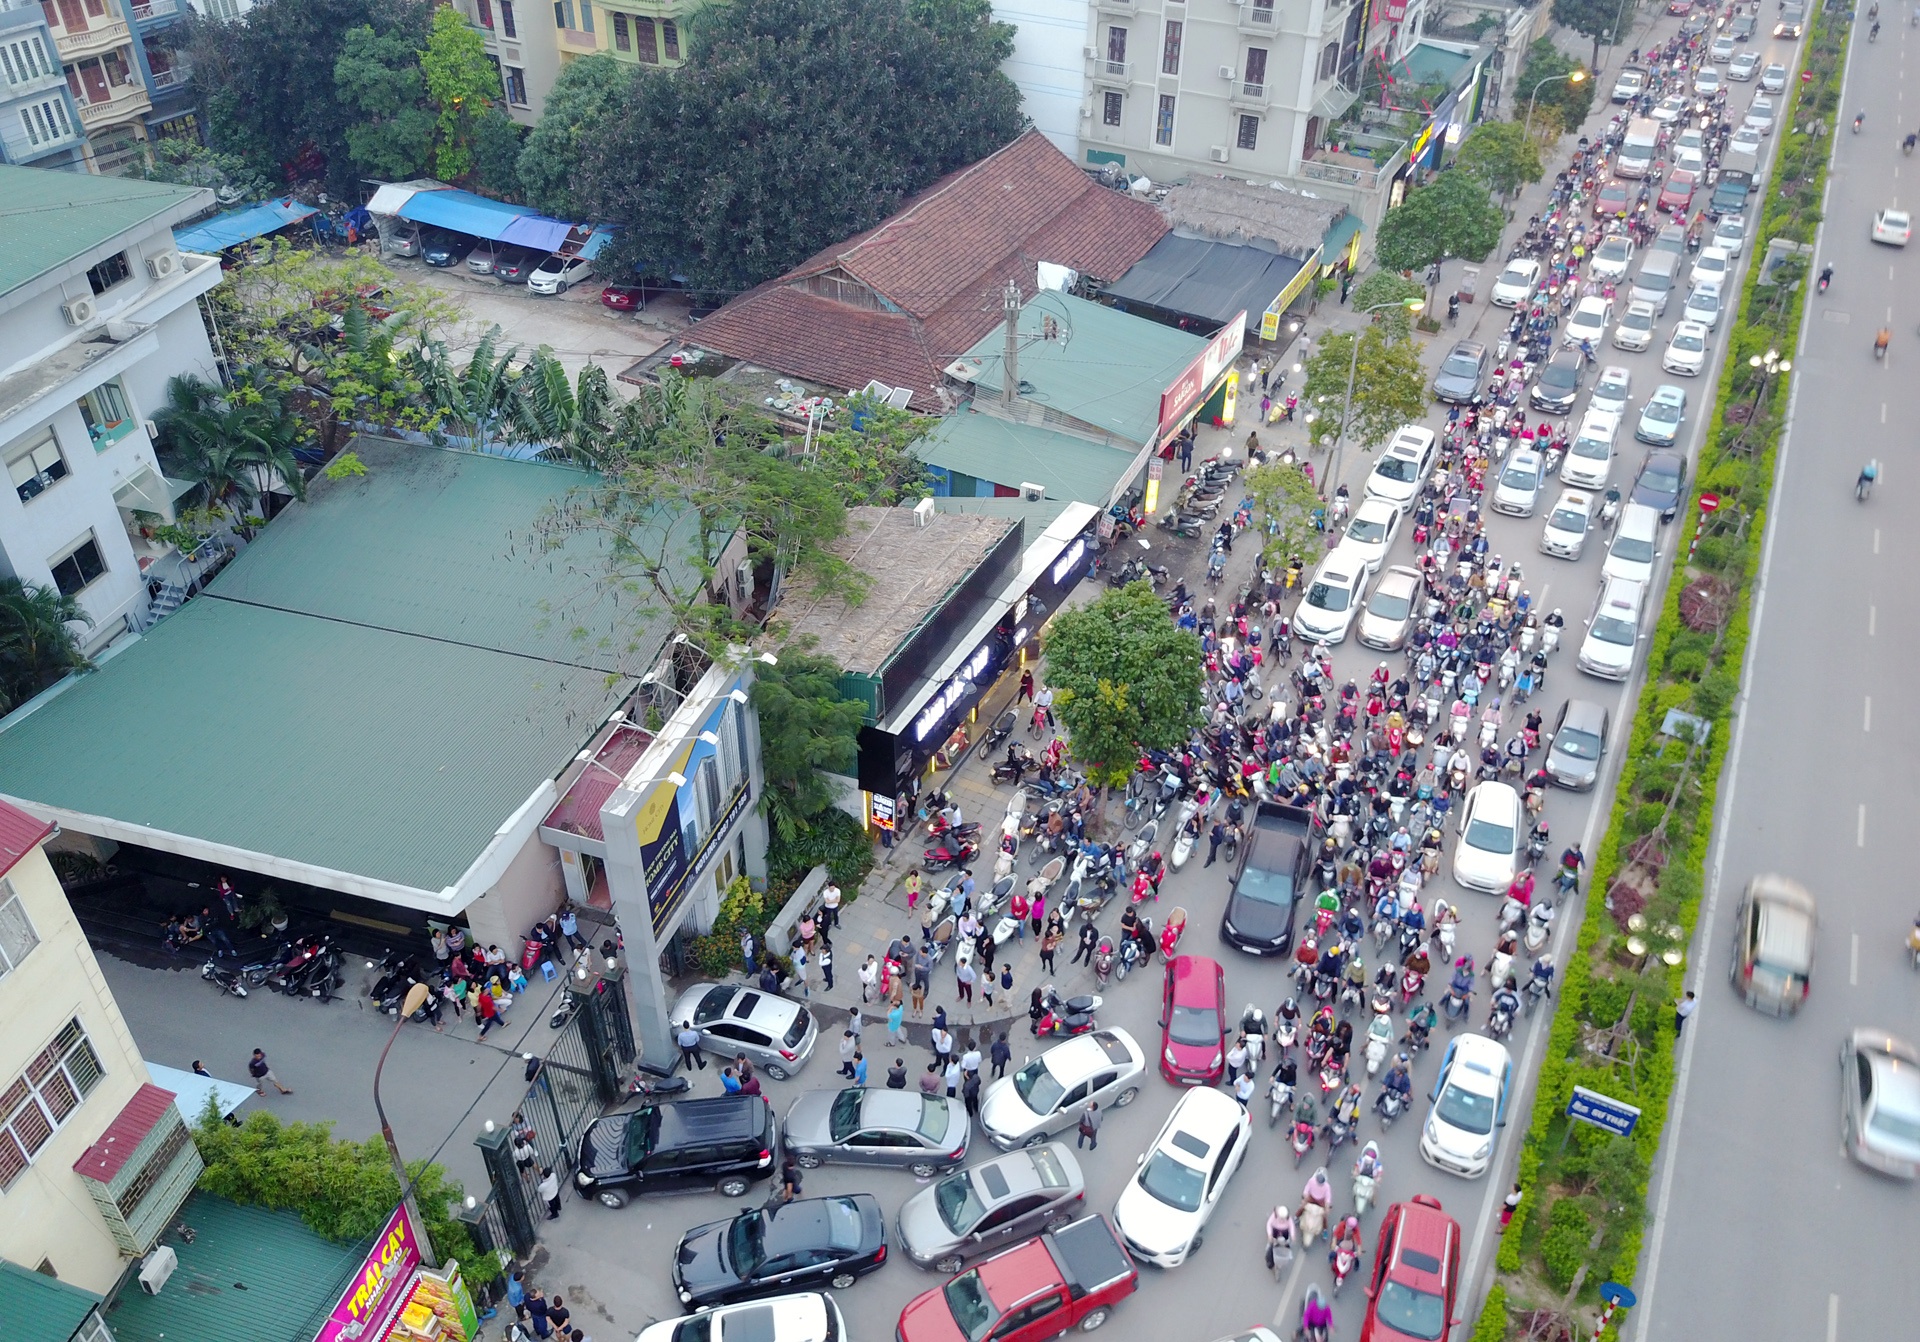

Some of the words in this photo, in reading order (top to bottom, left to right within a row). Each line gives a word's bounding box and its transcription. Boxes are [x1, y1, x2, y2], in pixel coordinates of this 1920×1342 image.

[663, 836, 679, 862] CITY
[347, 1261, 382, 1318] TRÁI
[381, 1219, 405, 1265] CÂY
